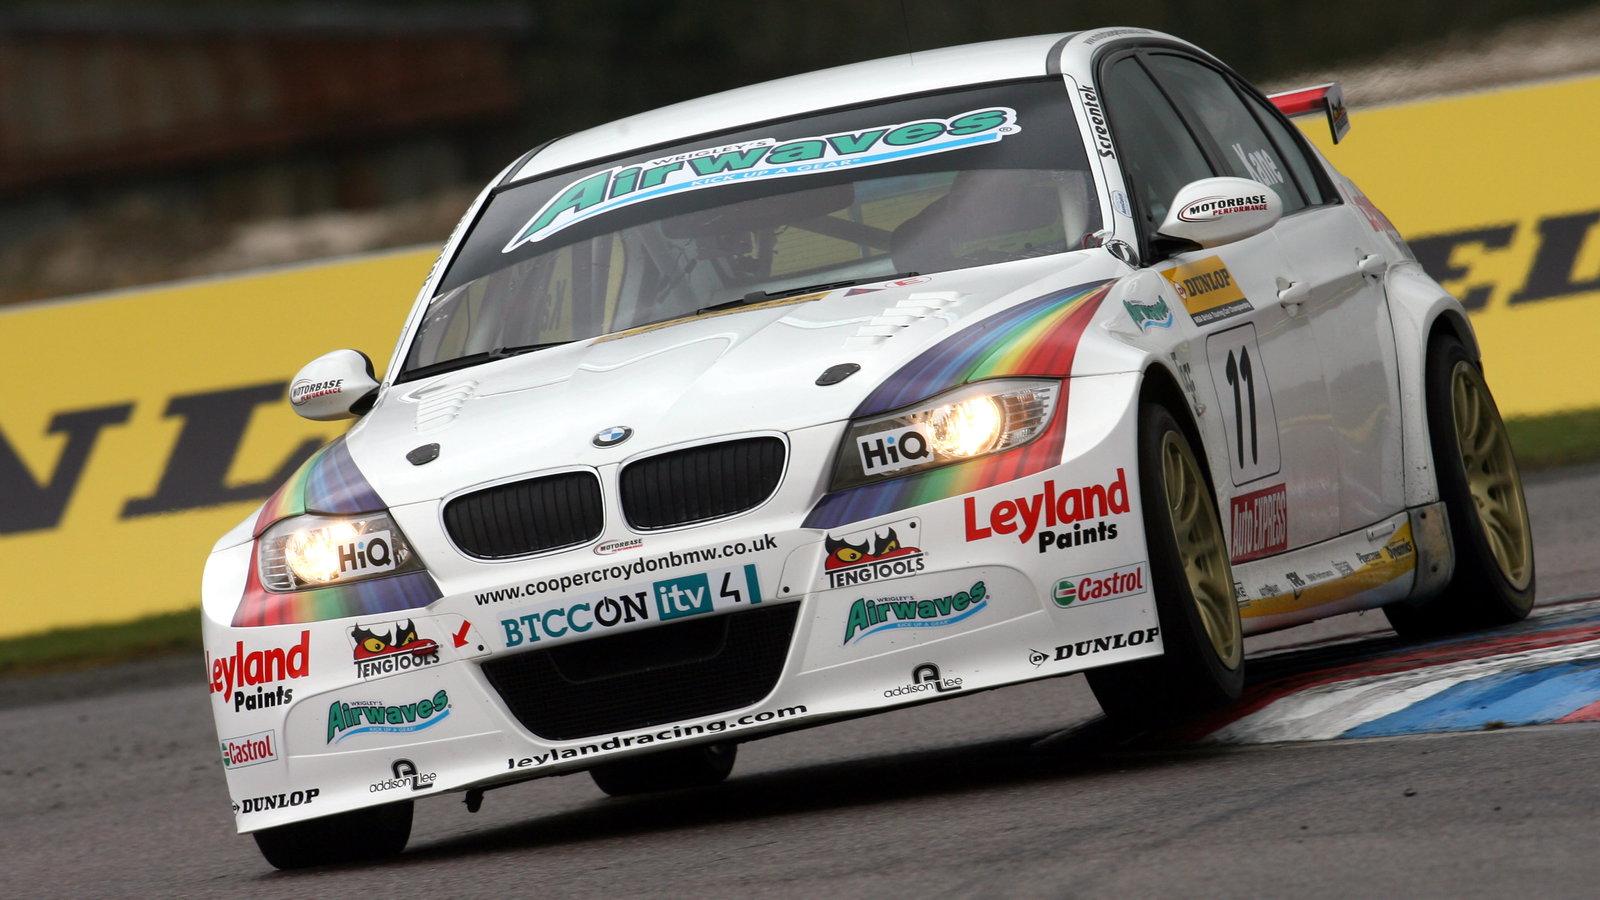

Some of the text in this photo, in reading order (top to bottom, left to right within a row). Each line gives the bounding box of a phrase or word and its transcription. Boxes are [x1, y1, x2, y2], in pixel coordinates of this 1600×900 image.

[1079, 85, 1115, 159] Screentek
[653, 140, 768, 166] WRIGLEY'S
[508, 108, 1010, 248] Airwaves
[690, 173, 733, 187] KICK
[743, 168, 767, 179] UP
[797, 160, 852, 172] GEAR
[1189, 195, 1267, 215] MOTORBASE
[1213, 204, 1268, 216] PERFORMANCE
[1183, 268, 1231, 297] DUNLOP
[293, 379, 344, 397] MOTORBASE
[1225, 345, 1258, 469] 11
[861, 431, 931, 470] HiQ
[964, 467, 1131, 544] Leyland
[1039, 521, 1118, 553] Paints
[1231, 490, 1287, 558] Auto EXPRESS
[337, 537, 392, 573] HiQ
[600, 539, 643, 551] MOTORBASE
[474, 533, 778, 606] www.coopercroydonbmw.co.uk
[1078, 566, 1143, 601] Castrol
[843, 581, 987, 645] Airwaves
[1053, 626, 1159, 661] DUNLOP
[234, 685, 293, 713] Paints
[884, 675, 963, 698] addison lee
[327, 689, 449, 745] Airwaves
[229, 735, 274, 765] Castrol
[507, 703, 808, 769] leylandracing.com
[369, 771, 436, 793] addison lee
[242, 788, 320, 814] DUNLOP
